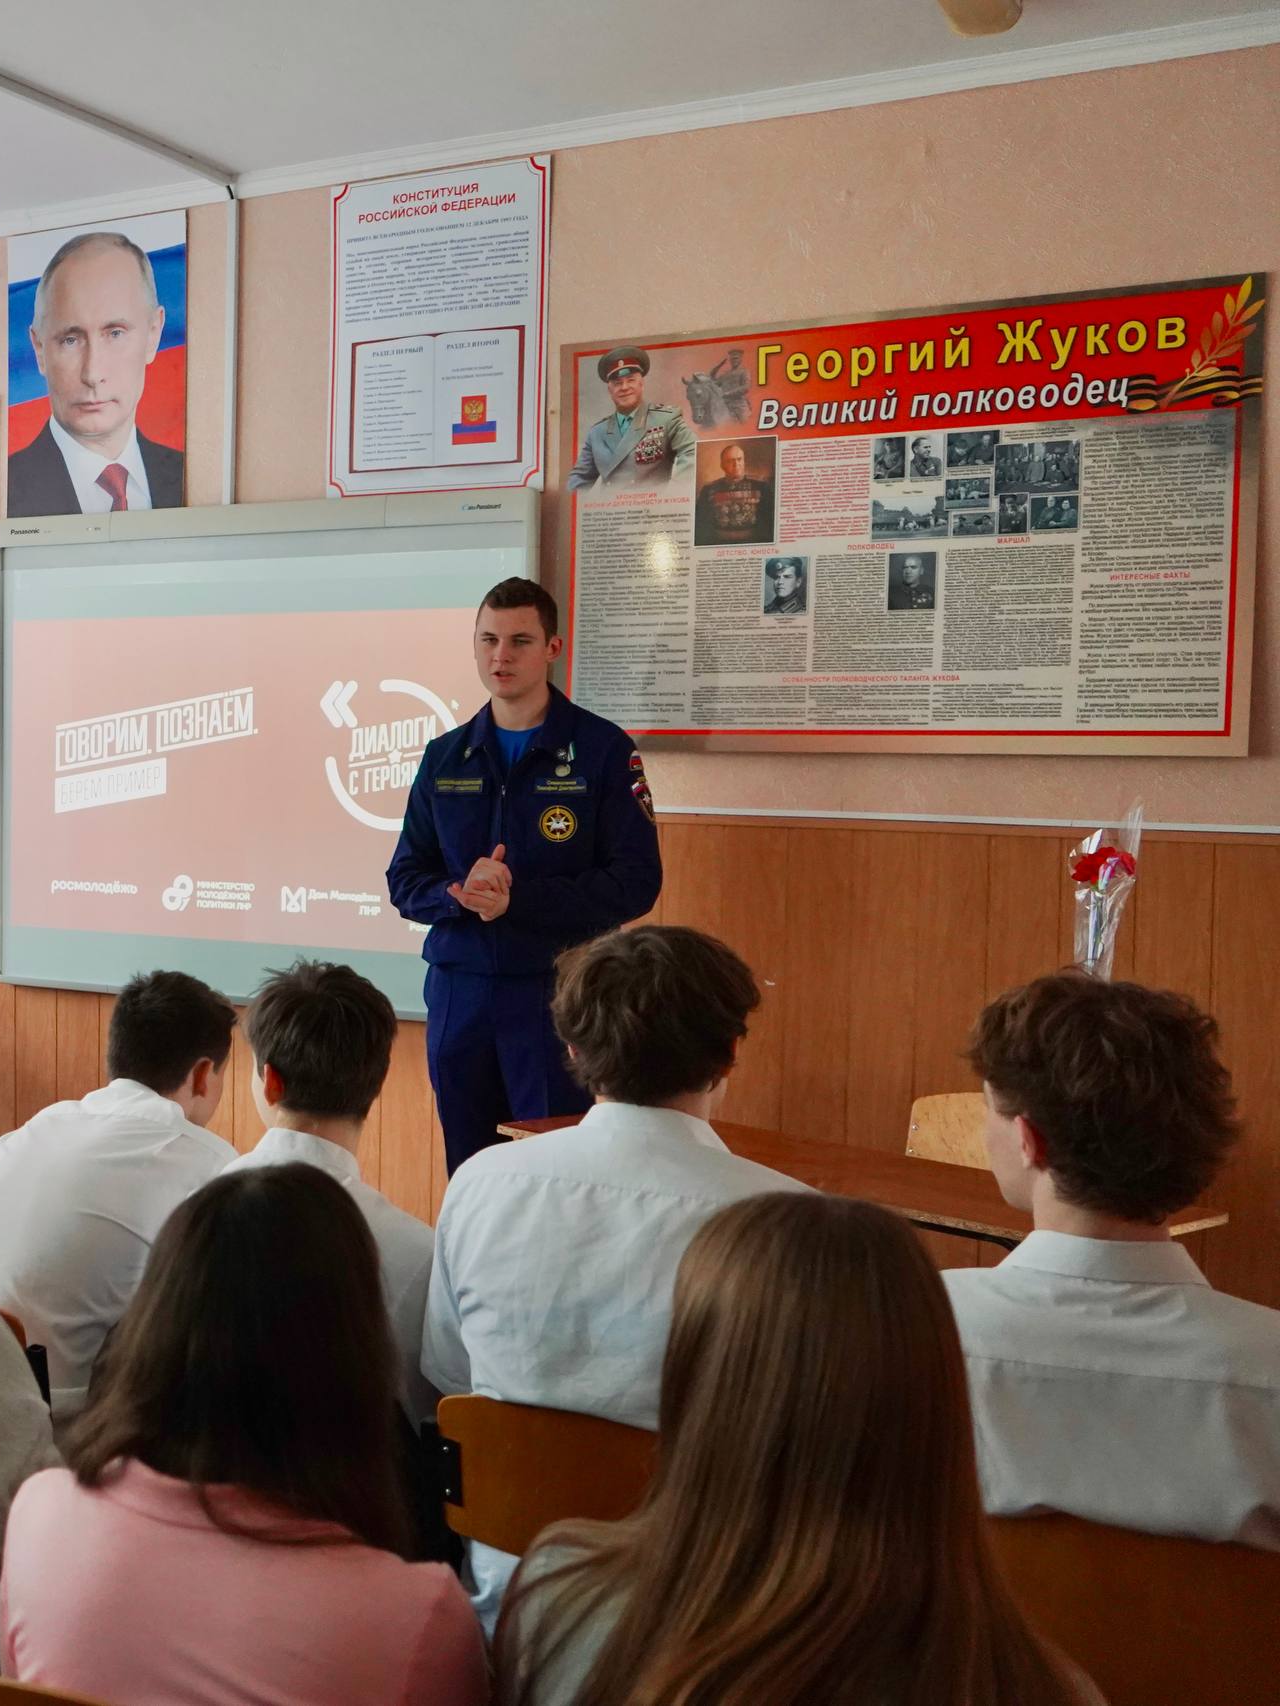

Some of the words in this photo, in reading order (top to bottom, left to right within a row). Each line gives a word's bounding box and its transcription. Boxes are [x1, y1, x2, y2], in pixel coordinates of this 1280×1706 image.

[393, 183, 479, 204] КОНСТИТУЦИЯ
[358, 202, 438, 224] РОССИЙСКОЙ
[441, 193, 516, 213] ФЕДЕРАЦИИ
[757, 325, 971, 388] Георгий
[996, 315, 1187, 371] Жуков
[757, 388, 897, 430] Великий
[909, 372, 1130, 419] полководец
[10, 527, 40, 535] Panasonic
[847, 543, 895, 551] ПОЛКОВОДЕЦ
[997, 536, 1030, 544] МАРШАЛ
[1109, 572, 1161, 581] ИНТЕРЕСНЫЕ
[1163, 571, 1191, 579] ФАКТЫ
[349, 715, 437, 762] ДИАЛОГИ
[349, 770, 359, 796] С
[196, 880, 256, 892] МИНИСТЕРСТВО
[358, 905, 382, 917] ЛНР
